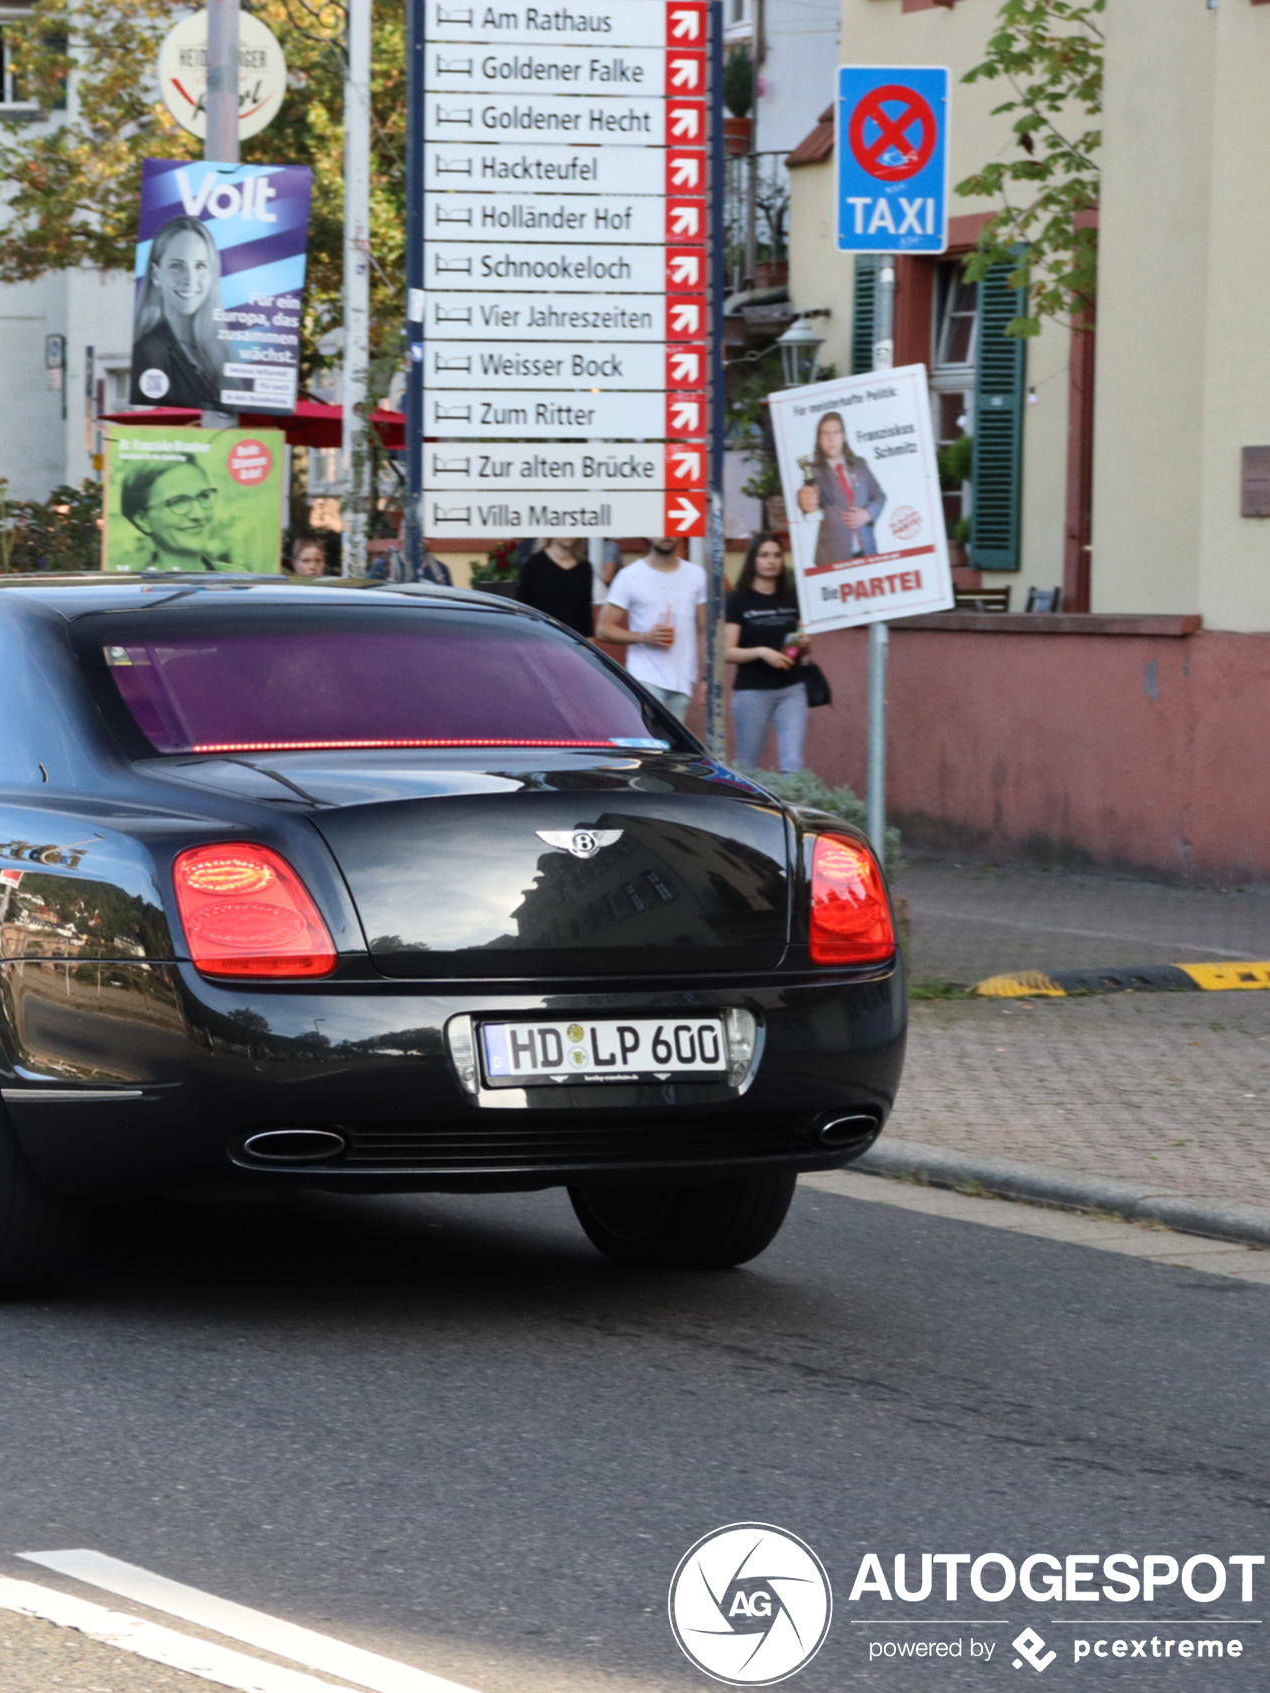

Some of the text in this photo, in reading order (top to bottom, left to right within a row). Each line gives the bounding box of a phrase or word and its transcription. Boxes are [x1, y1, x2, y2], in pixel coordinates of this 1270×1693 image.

[481, 7, 612, 33] Am Rathaus
[481, 56, 644, 83] Goldener Falke
[481, 105, 651, 133] Goldener Hecht
[481, 155, 598, 181] Hackteufel
[175, 170, 277, 223] Volt
[481, 204, 633, 231] Holländer Hof
[846, 196, 935, 235] TAXI
[480, 253, 632, 280] Schnookeloch
[276, 293, 301, 310] ein
[212, 308, 300, 328] Europa, das
[480, 303, 653, 329] Vier Jahreszeiten
[216, 329, 299, 346] zusammen
[480, 353, 624, 378] Weisser Bock
[480, 402, 596, 426] Zum Ritter
[855, 424, 915, 443] Franziskus
[873, 442, 918, 460] Schmitz
[478, 454, 656, 479] Zur alten Brücke
[477, 504, 612, 527] Villa Marstall
[838, 570, 923, 604] PARTEI
[509, 1025, 721, 1070] HD LP 600
